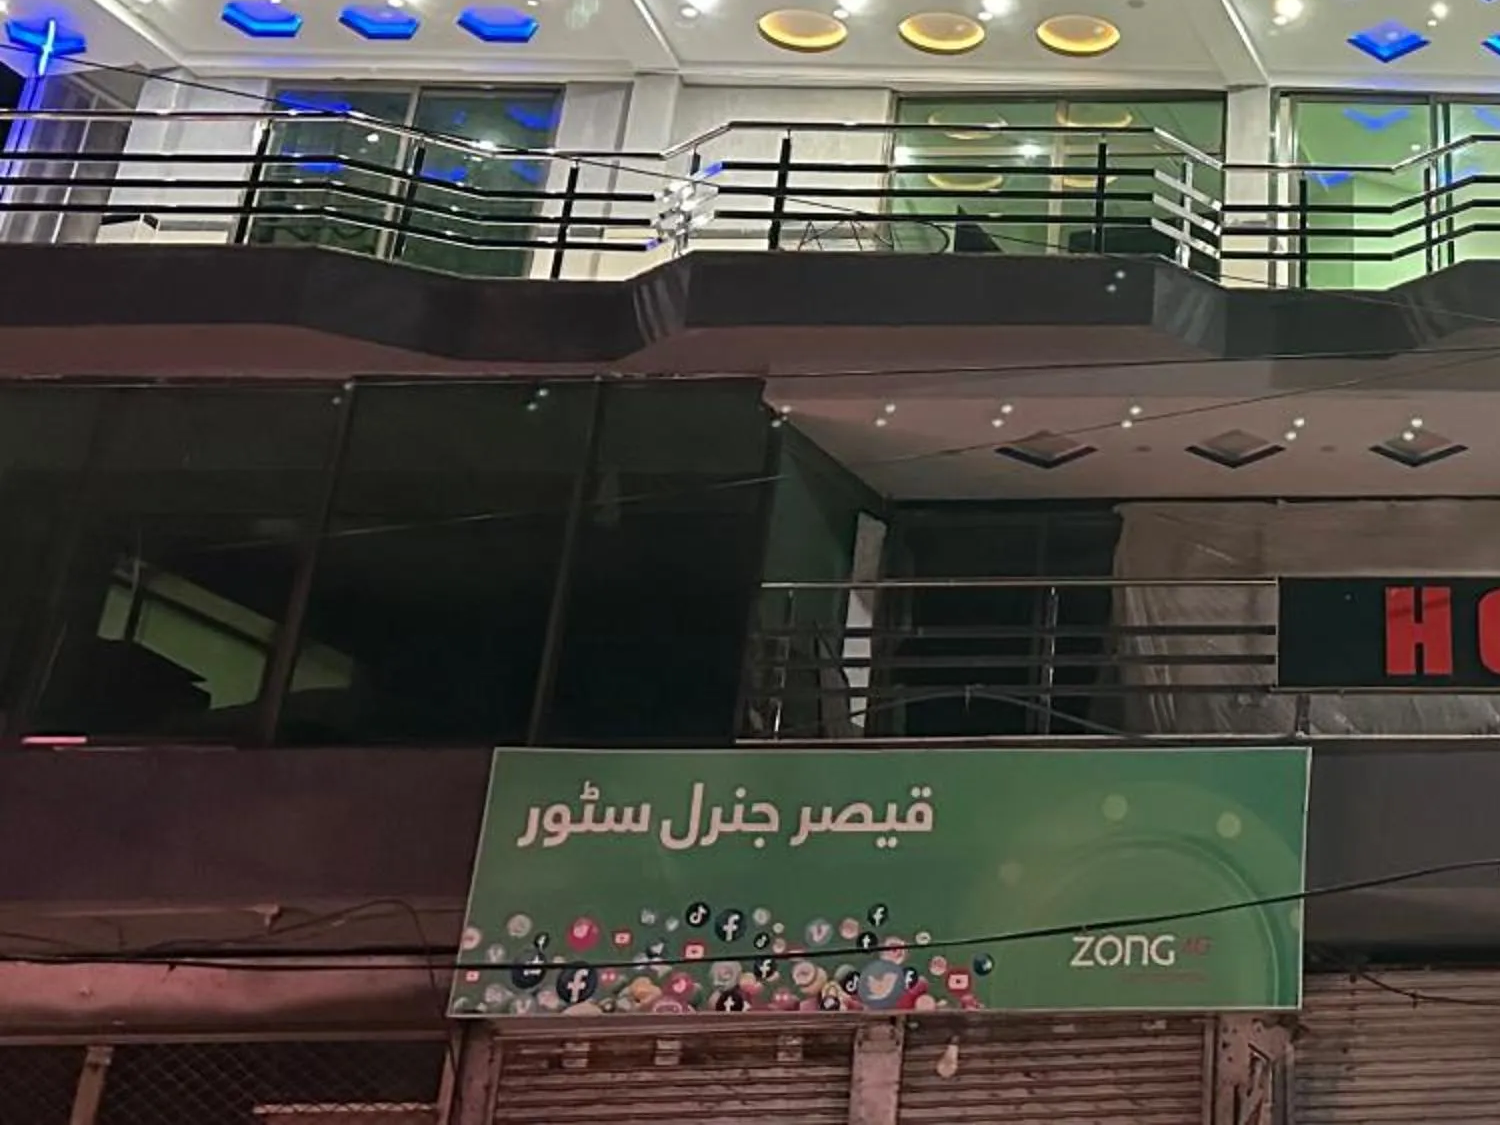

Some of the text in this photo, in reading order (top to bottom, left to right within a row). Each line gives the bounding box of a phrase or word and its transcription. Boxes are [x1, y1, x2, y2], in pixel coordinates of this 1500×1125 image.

[516, 781, 934, 850] قیصر جنرل سٹور
